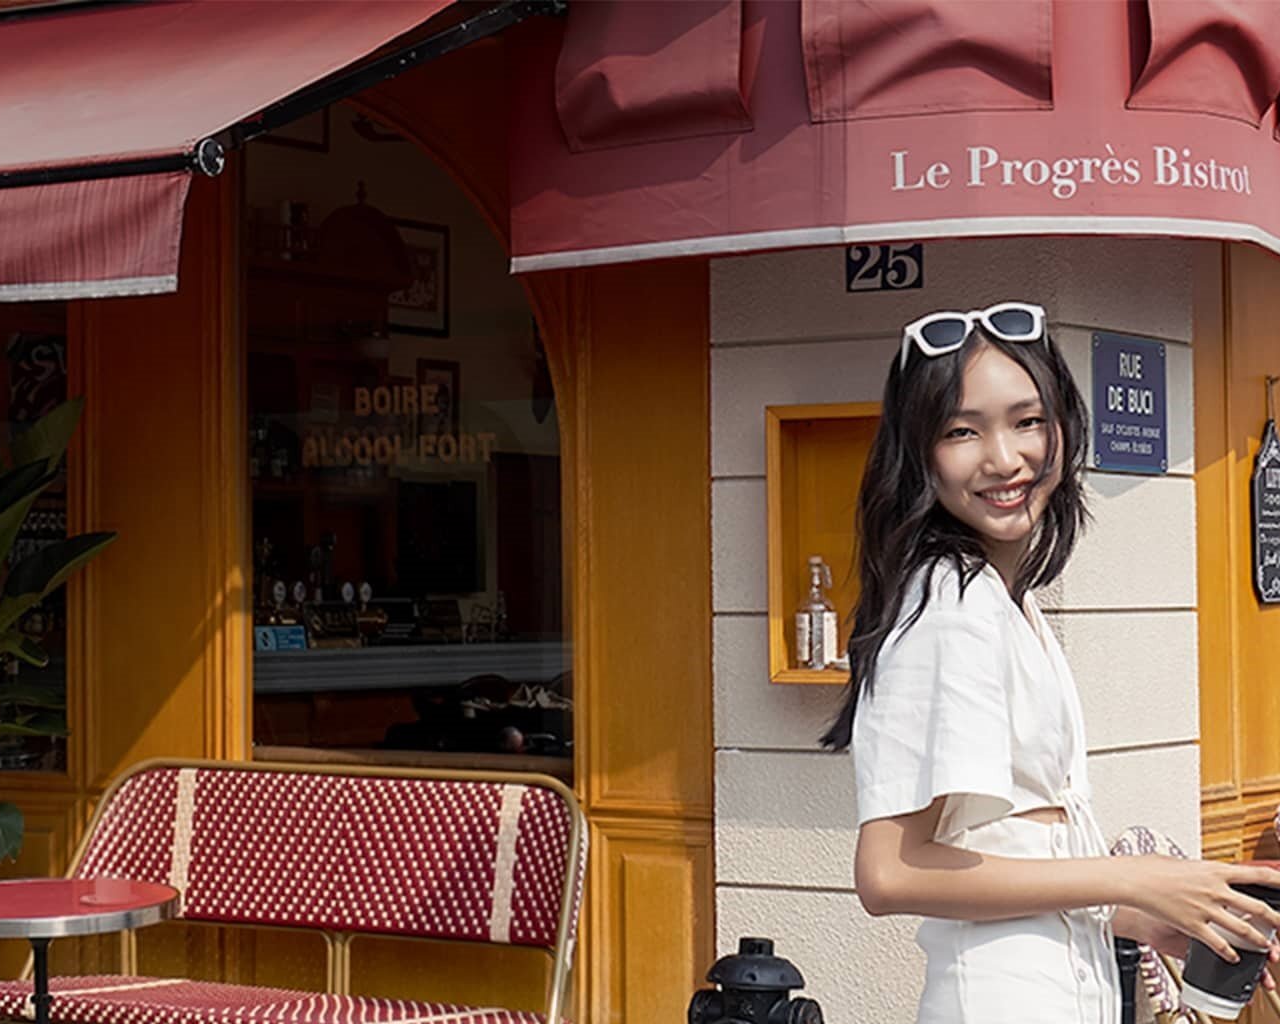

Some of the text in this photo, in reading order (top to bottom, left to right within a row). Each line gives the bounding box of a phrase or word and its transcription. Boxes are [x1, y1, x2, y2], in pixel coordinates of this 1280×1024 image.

[890, 143, 1252, 199] Le Progrès Bistrot
[849, 244, 919, 289] 25
[1119, 351, 1142, 379] RUE
[354, 384, 439, 417] BOIRE
[1107, 384, 1124, 412] DE
[420, 431, 497, 465] FORT
